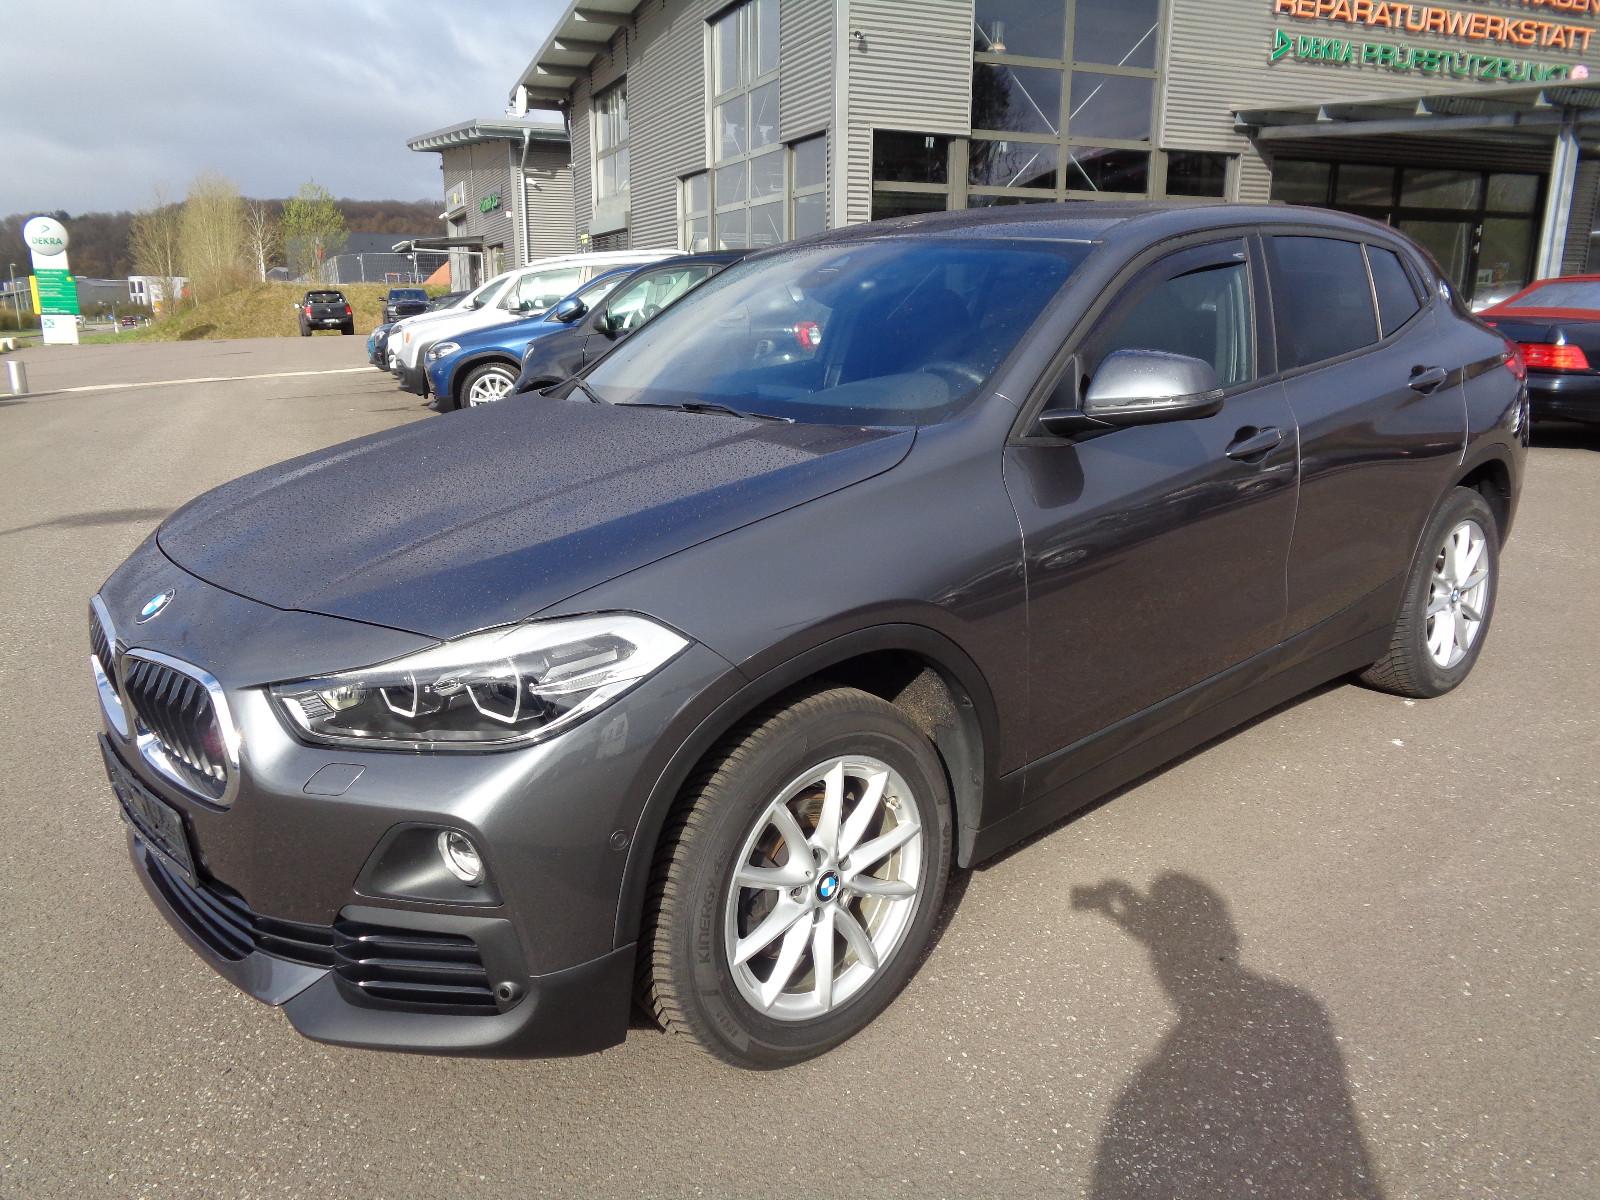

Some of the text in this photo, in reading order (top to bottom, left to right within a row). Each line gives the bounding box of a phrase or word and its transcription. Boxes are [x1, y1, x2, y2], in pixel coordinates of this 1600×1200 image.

[1274, 0, 1596, 49] REPARATURWERKSTATT
[1297, 34, 1355, 61] DEKRA
[31, 236, 63, 245] DEKRA
